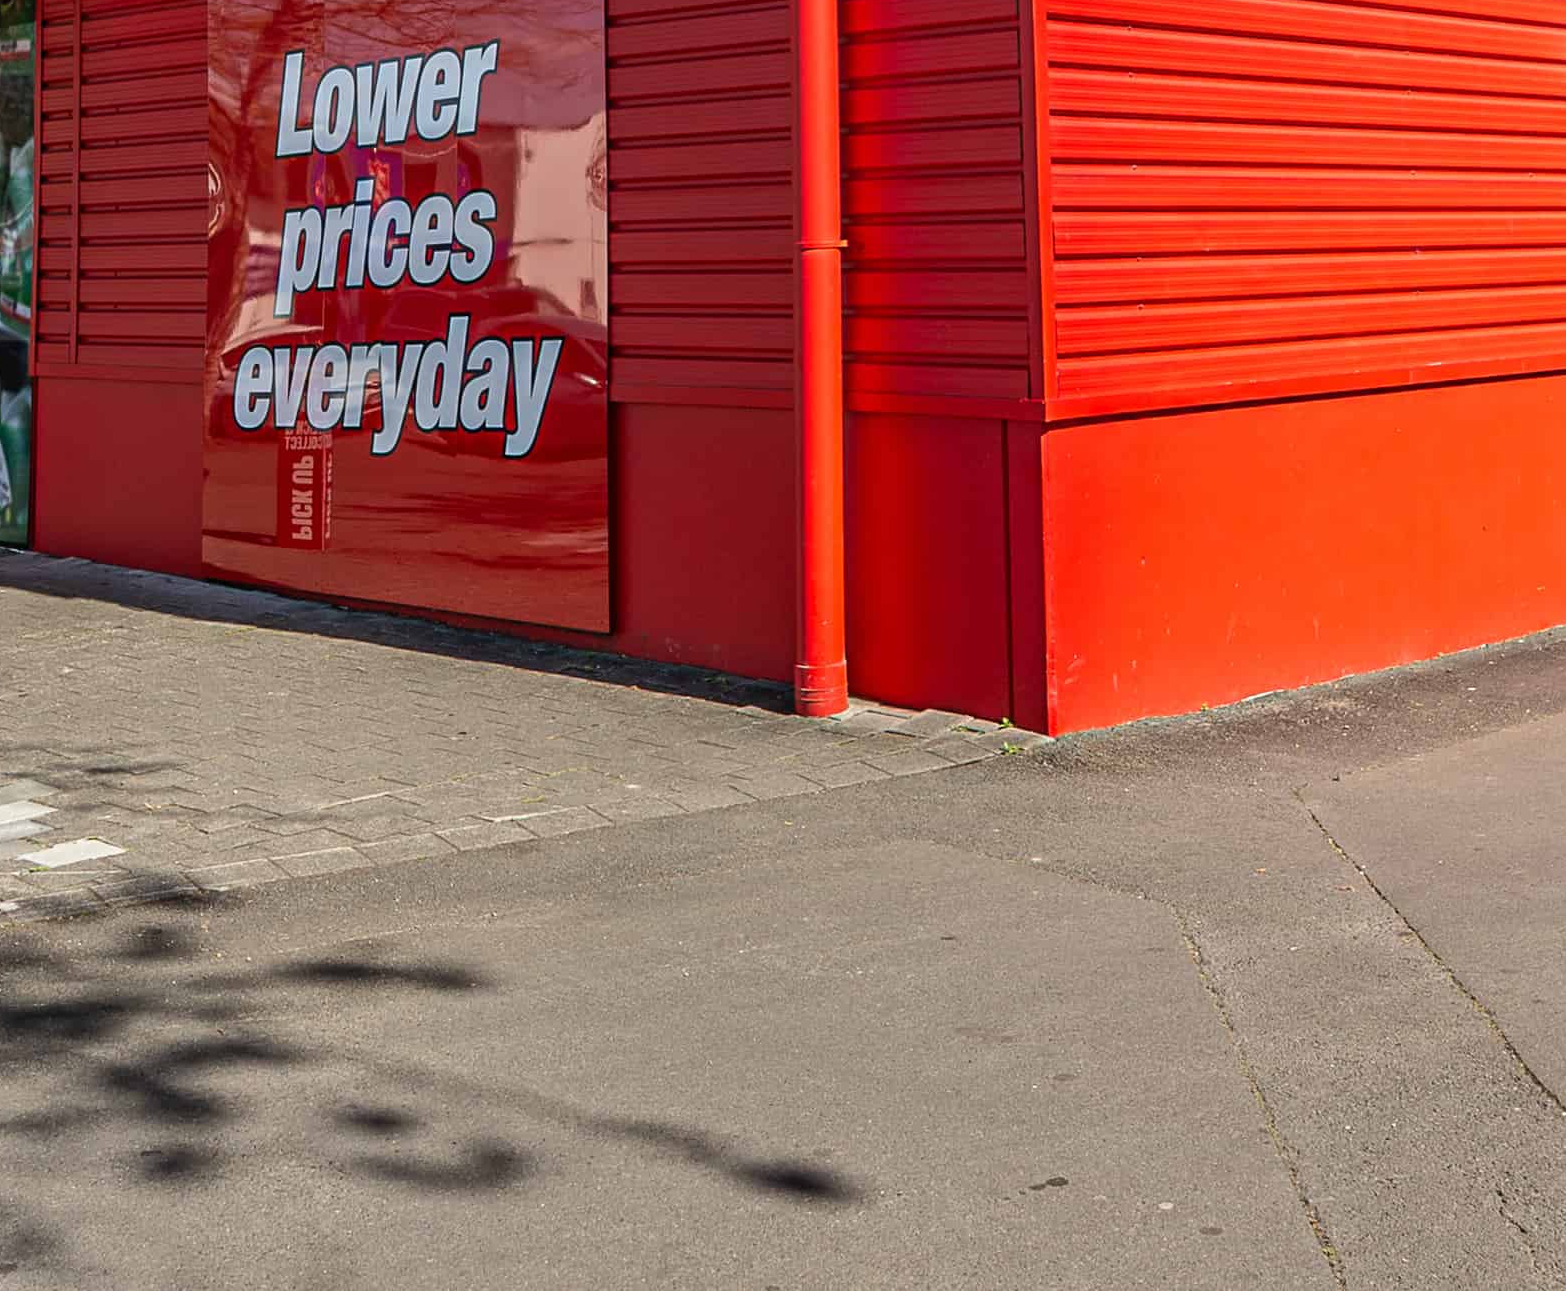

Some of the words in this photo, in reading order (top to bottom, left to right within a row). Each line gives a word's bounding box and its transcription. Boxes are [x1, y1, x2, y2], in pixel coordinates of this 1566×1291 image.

[274, 39, 499, 157] Lower
[273, 178, 498, 318] prices
[232, 313, 563, 457] everyday
